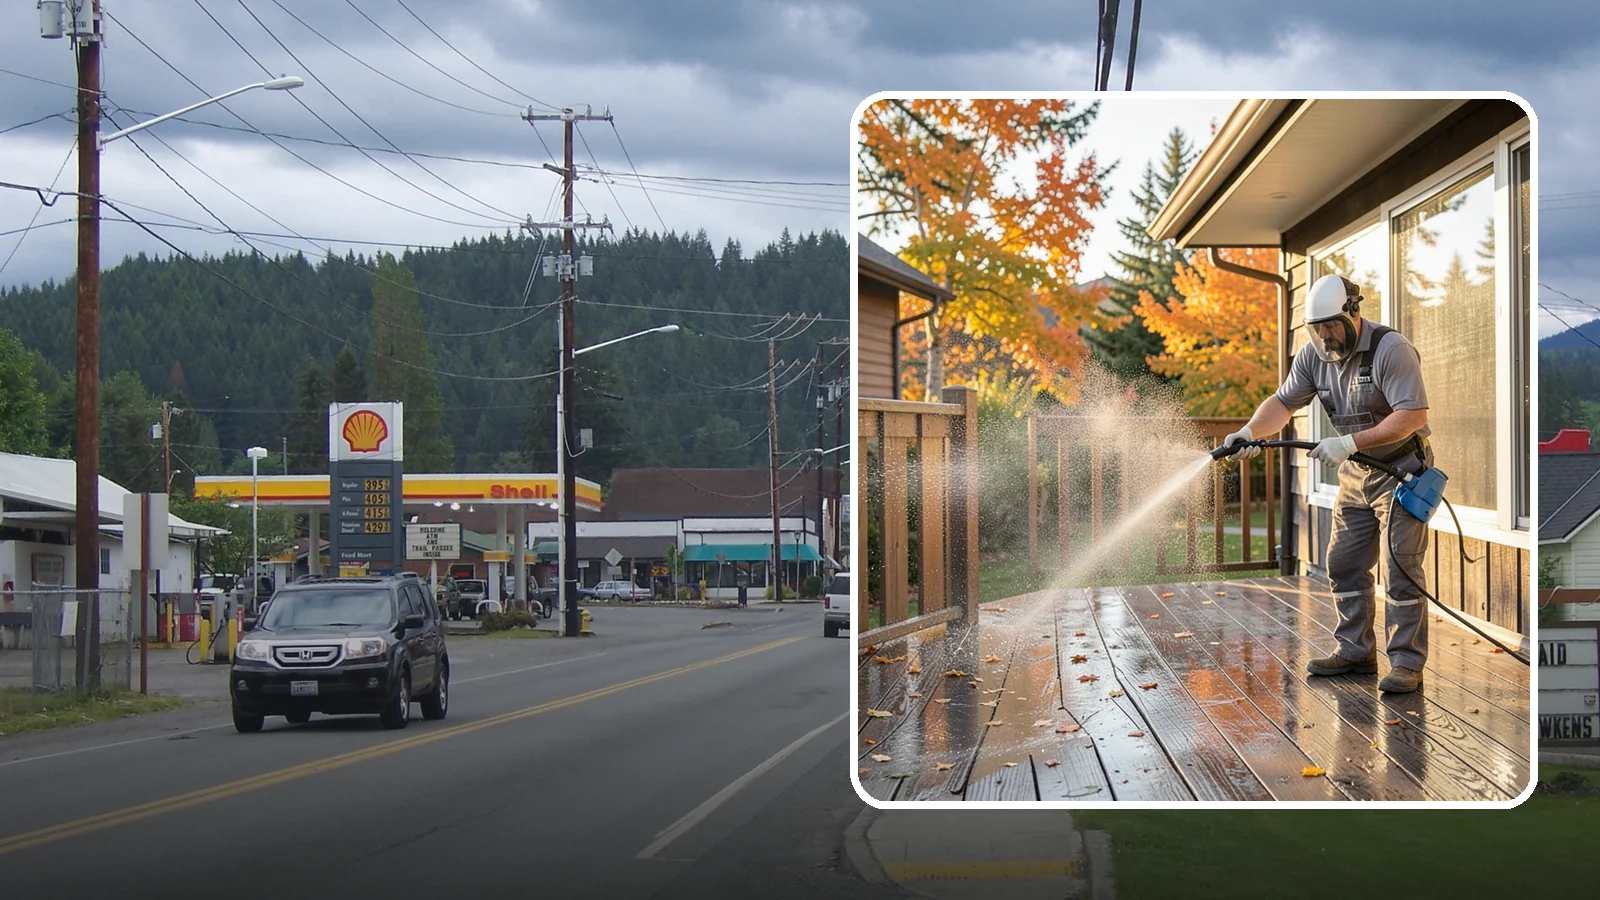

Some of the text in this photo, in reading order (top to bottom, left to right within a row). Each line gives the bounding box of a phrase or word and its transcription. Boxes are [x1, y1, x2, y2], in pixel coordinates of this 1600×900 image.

[366, 480, 384, 490] 395
[490, 484, 547, 498] Shell
[366, 494, 384, 504] 405
[366, 508, 384, 518] 415
[366, 522, 384, 532] 429
